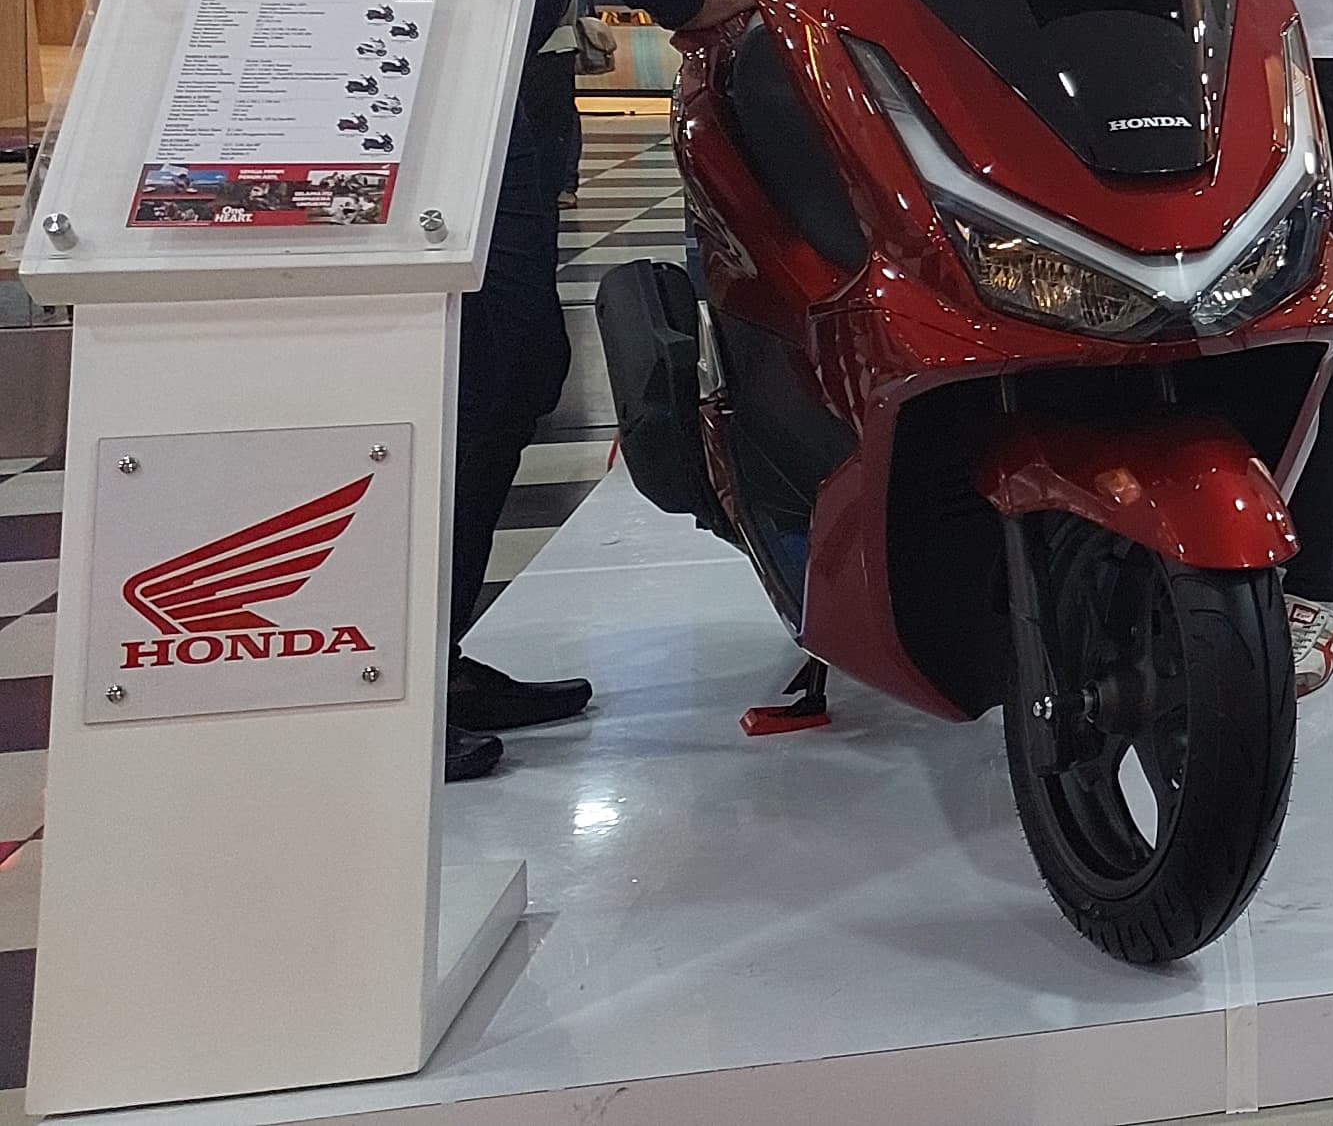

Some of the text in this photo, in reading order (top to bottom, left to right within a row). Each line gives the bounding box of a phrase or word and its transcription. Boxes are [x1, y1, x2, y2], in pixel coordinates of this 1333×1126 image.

[1108, 116, 1193, 132] HONDA
[221, 205, 246, 215] One
[119, 624, 377, 670] HONDA
